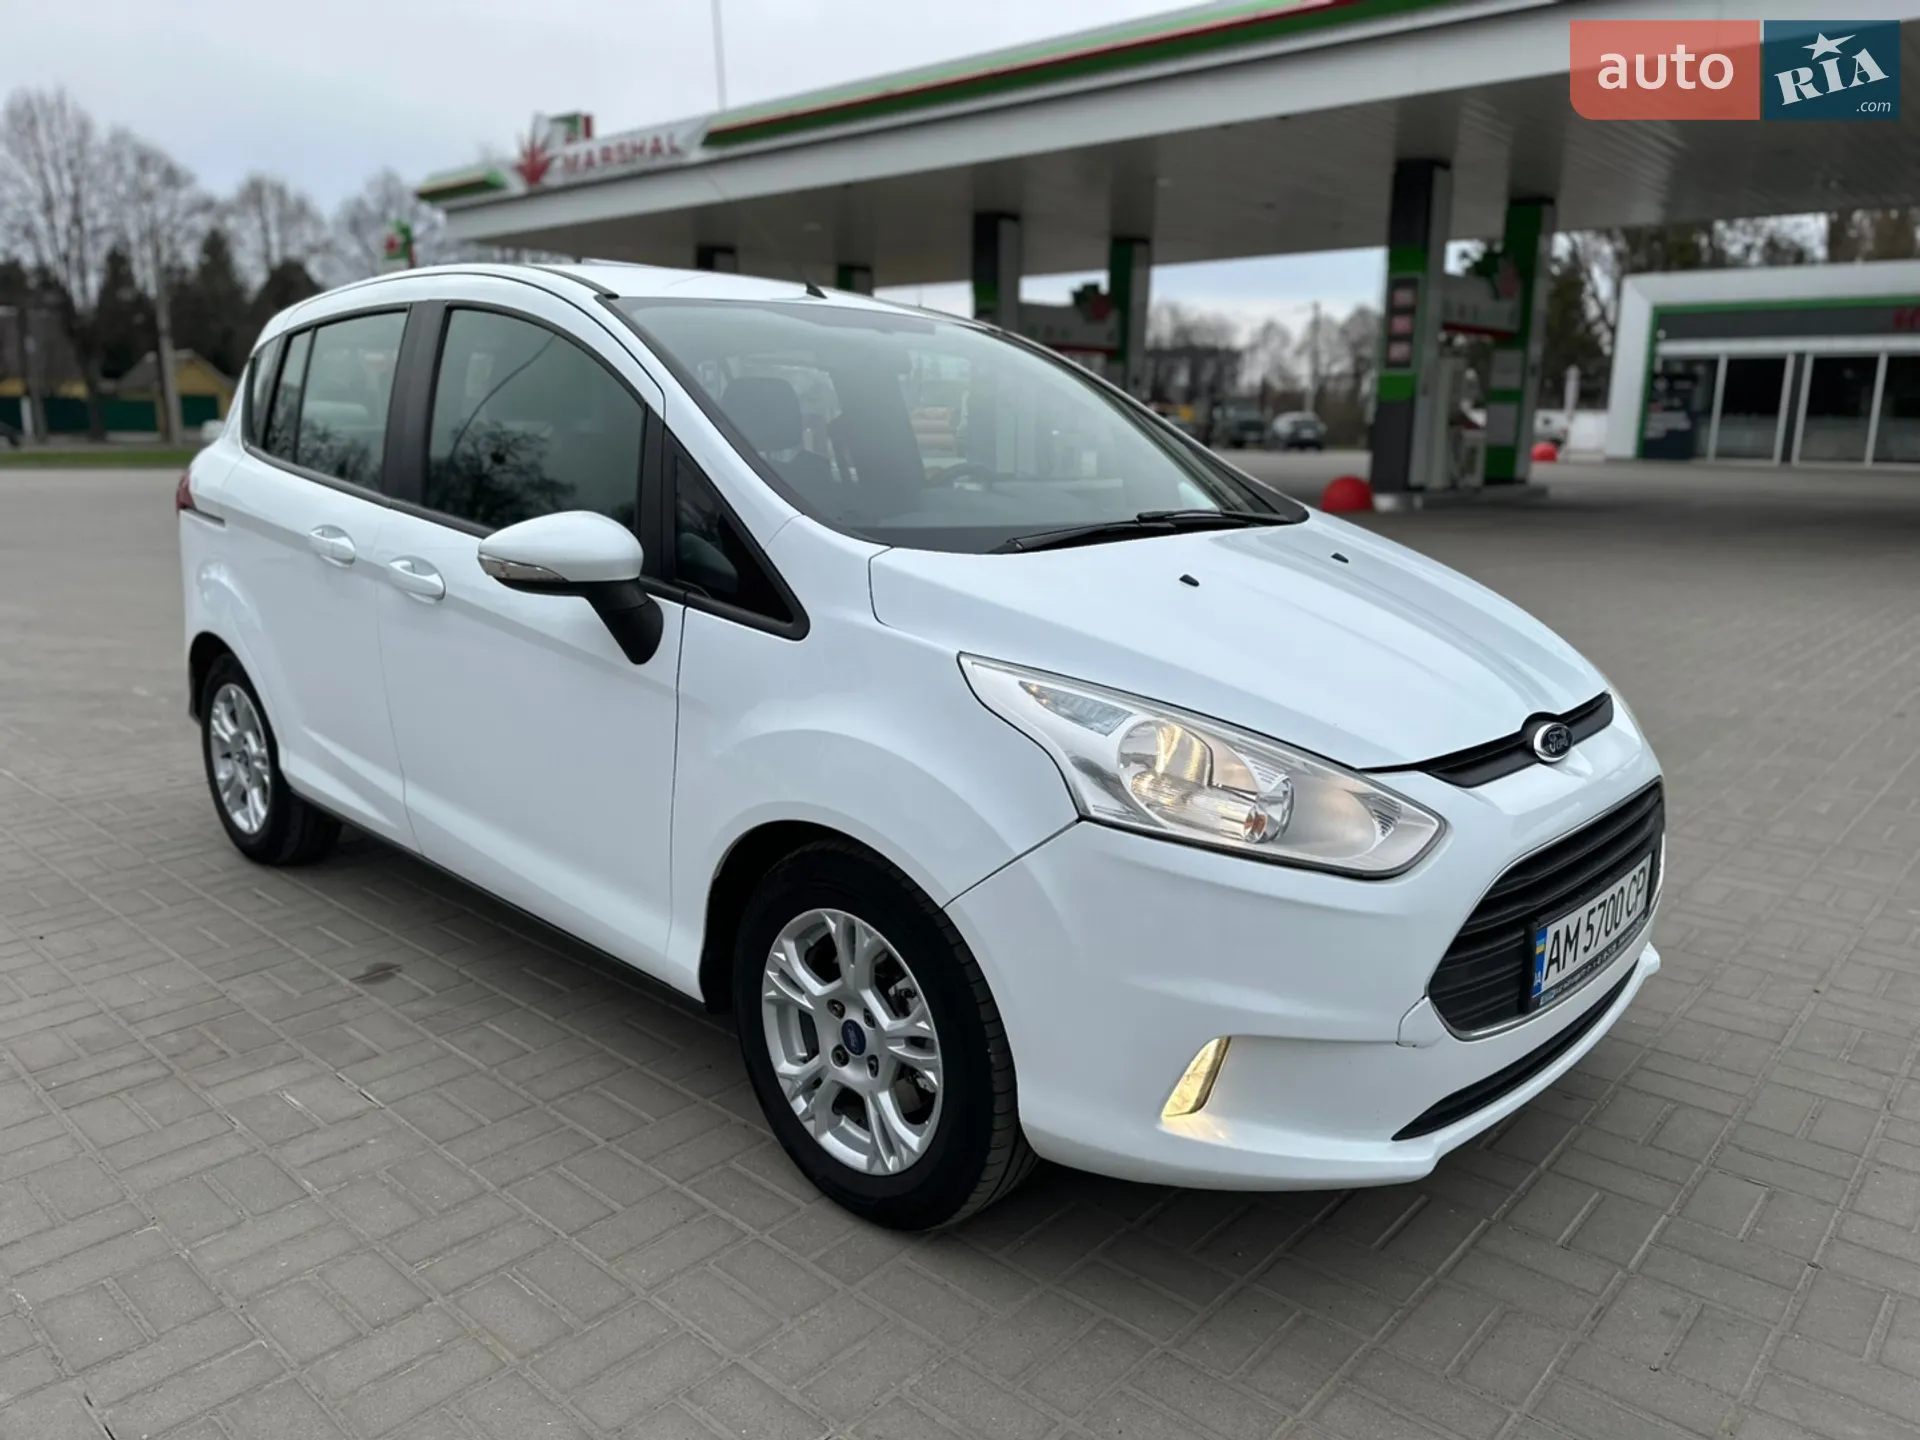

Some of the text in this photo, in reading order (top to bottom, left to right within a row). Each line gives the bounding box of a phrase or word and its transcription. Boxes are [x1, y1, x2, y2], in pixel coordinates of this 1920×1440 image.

[565, 132, 681, 172] MARSHAL
[1544, 917, 1581, 982] AM
[1583, 886, 1624, 954] 5700
[1626, 867, 1647, 918] CP
